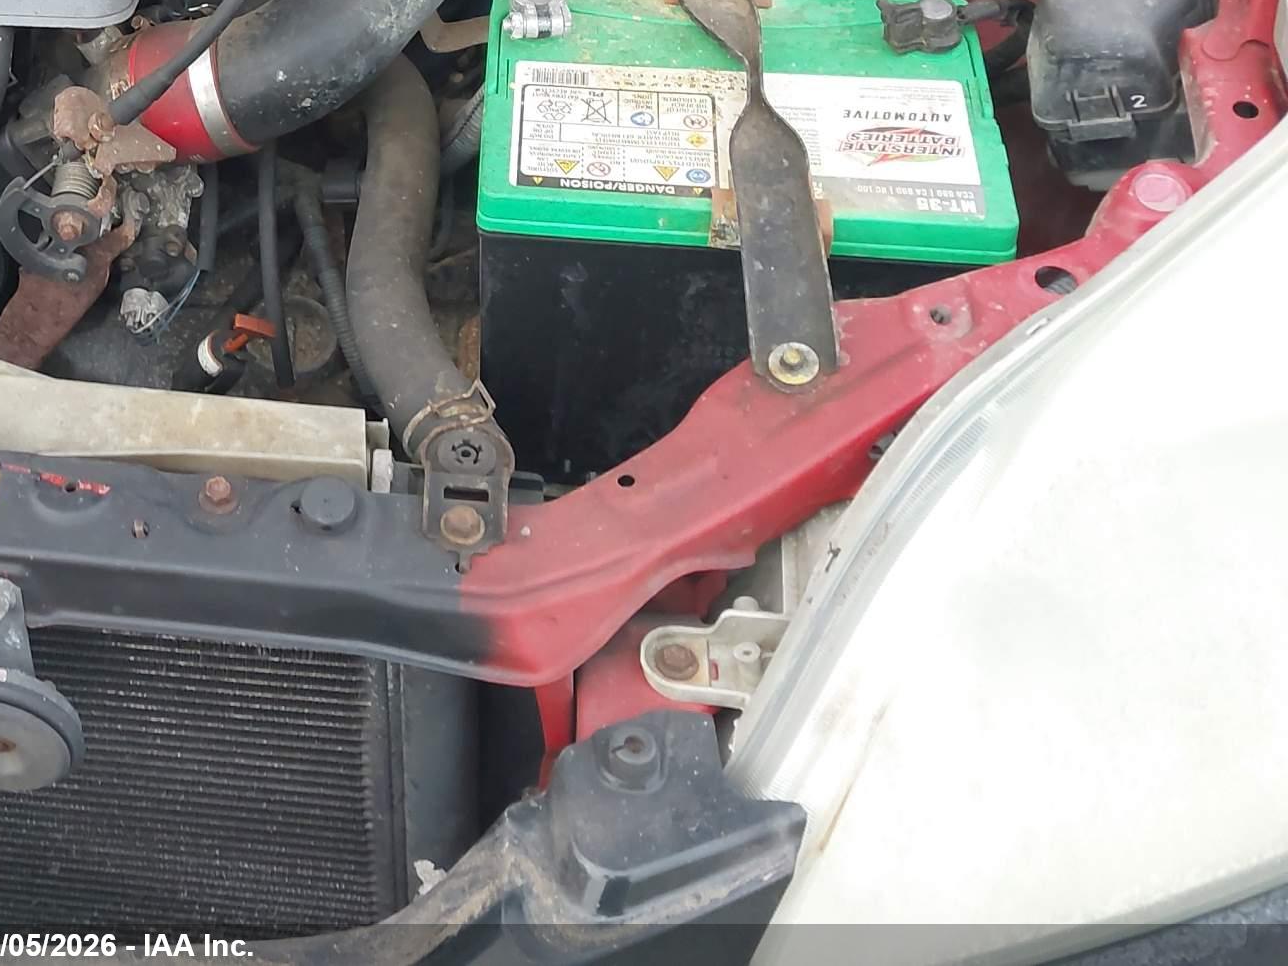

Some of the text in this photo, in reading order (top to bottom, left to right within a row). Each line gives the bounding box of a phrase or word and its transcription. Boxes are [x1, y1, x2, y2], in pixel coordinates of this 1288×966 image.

[1130, 94, 1148, 108] 2
[842, 109, 952, 122] AUTOMOTIVE
[848, 132, 956, 145] BATTERIES
[842, 141, 962, 156] INTERSTATE
[559, 178, 675, 194] DANGER/POISON
[915, 196, 977, 213] MT-35
